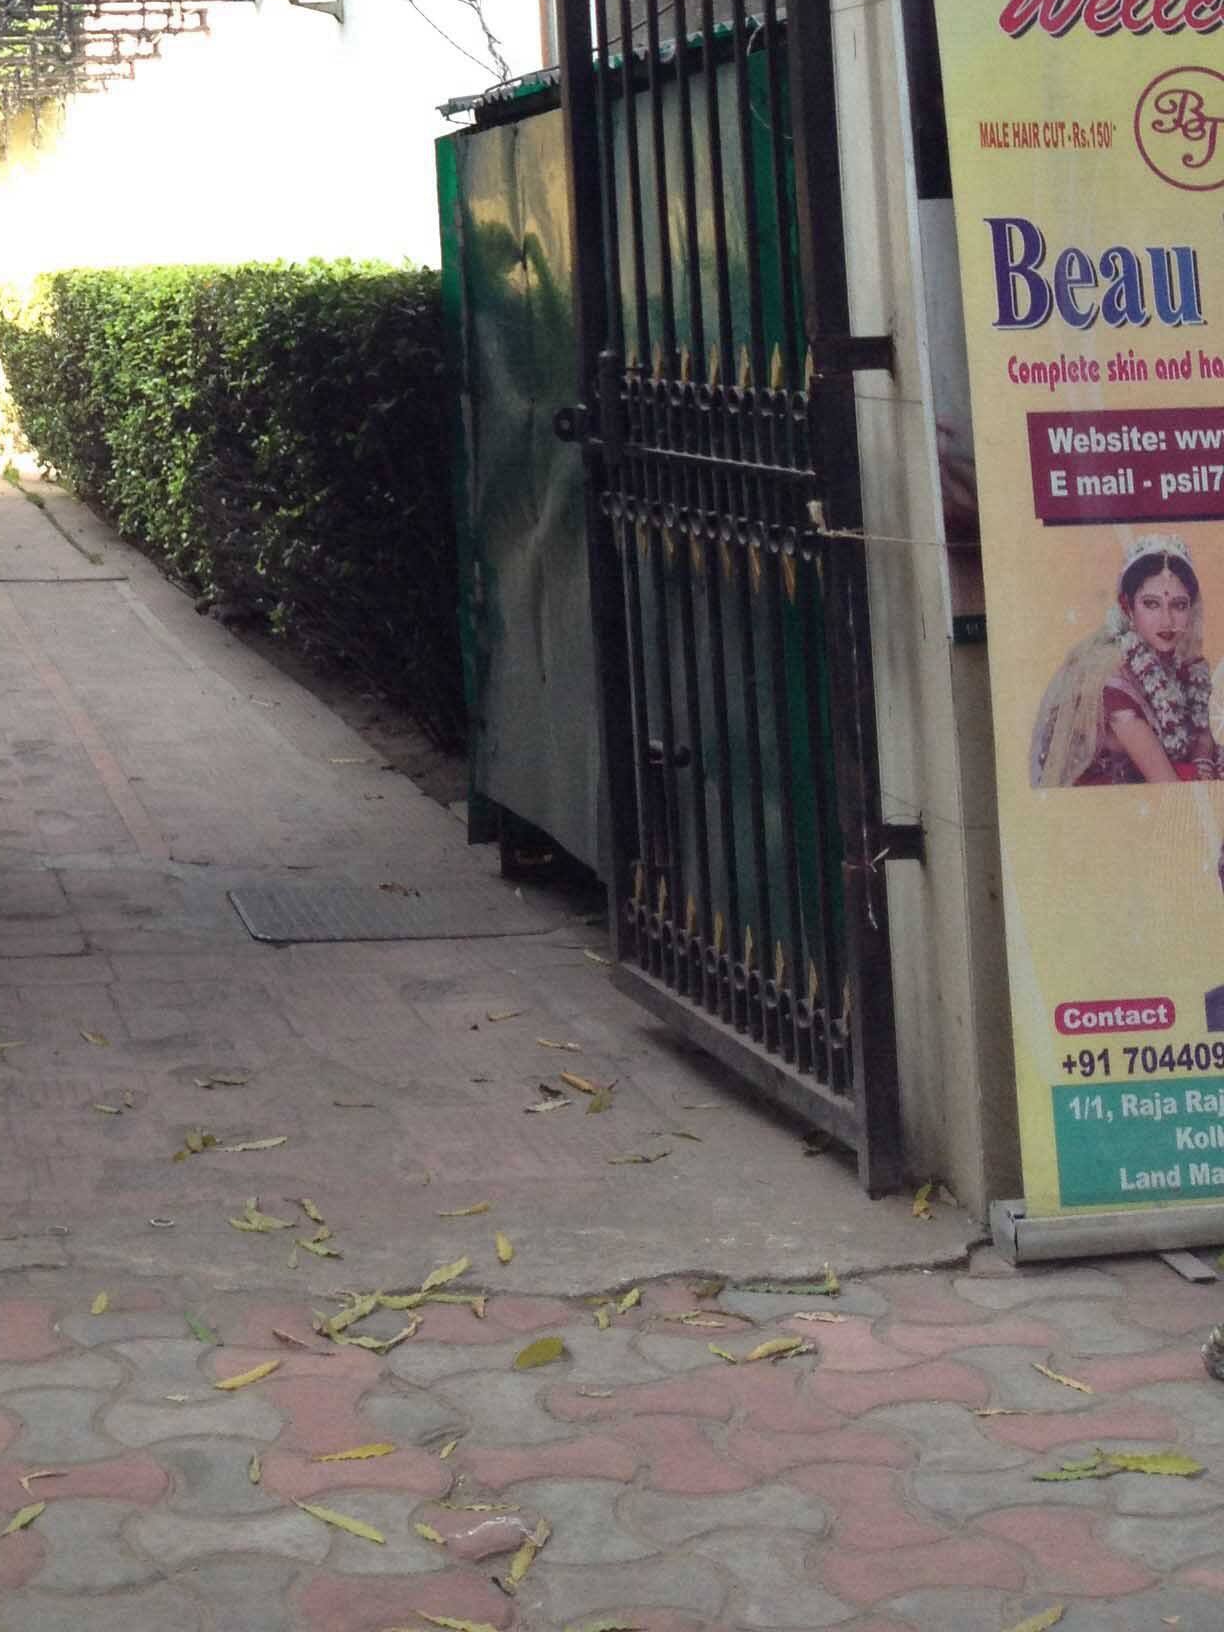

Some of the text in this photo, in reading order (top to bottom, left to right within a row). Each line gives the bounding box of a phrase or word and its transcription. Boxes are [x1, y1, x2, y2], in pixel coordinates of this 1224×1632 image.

[979, 121, 1009, 149] MALE
[1012, 121, 1040, 148] HAIR
[1043, 121, 1066, 148] CUT
[983, 218, 1208, 330] Beau
[1007, 354, 1101, 392] Complete
[1107, 350, 1148, 381] skin
[1155, 349, 1192, 380] and
[1048, 427, 1167, 454] Website:
[1049, 470, 1068, 497] E
[1077, 469, 1135, 496] mail
[1063, 1004, 1168, 1029] Contact
[1062, 1048, 1111, 1077] +91
[1069, 1094, 1114, 1123] 1/1,
[1121, 1092, 1177, 1120] Raja
[1120, 1166, 1181, 1191] Land
